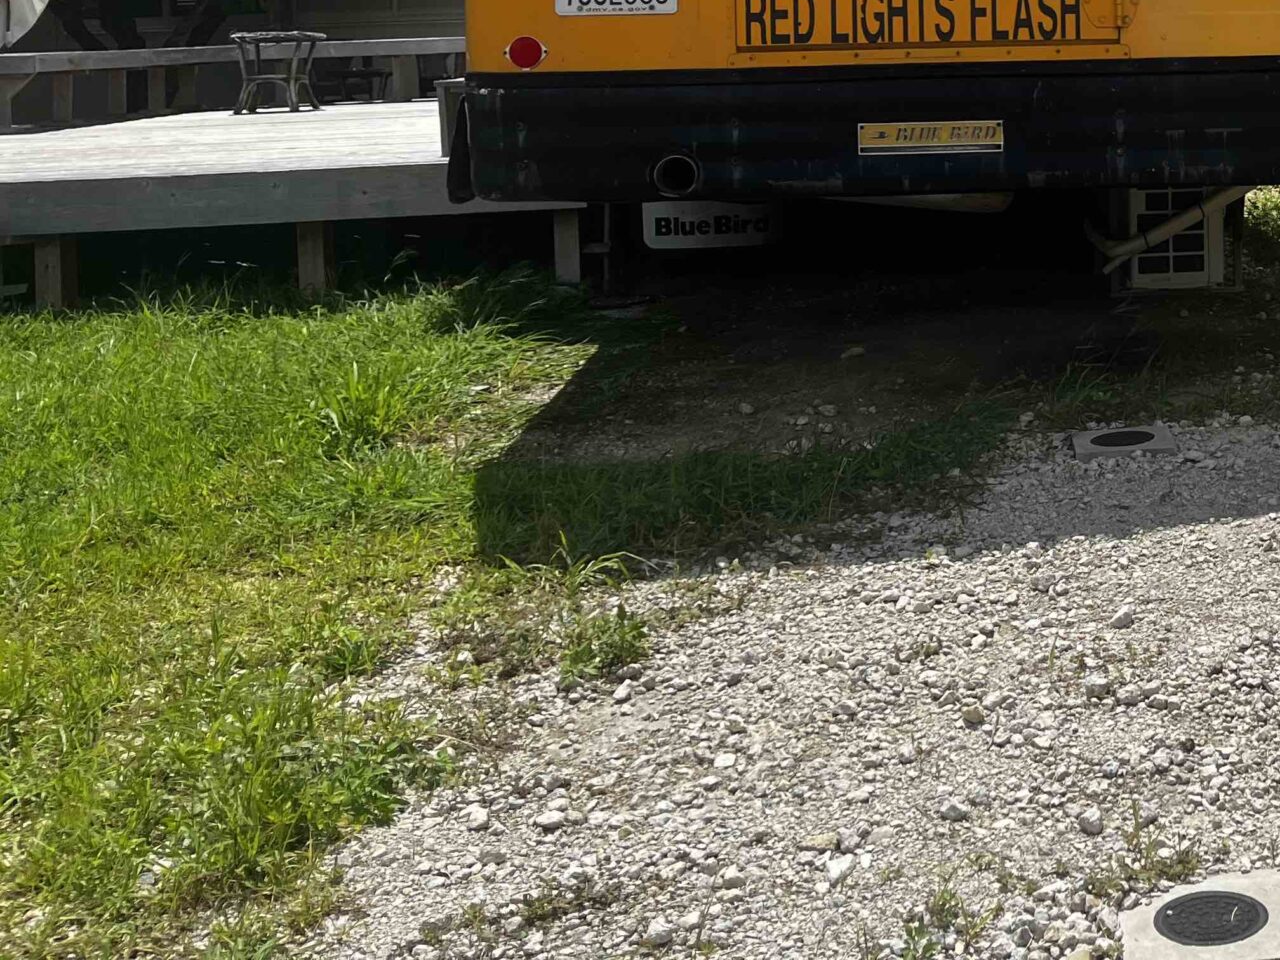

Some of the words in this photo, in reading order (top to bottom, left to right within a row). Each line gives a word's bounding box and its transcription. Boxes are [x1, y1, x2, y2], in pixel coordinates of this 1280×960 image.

[584, 6, 648, 14] dmv.ca.gov
[895, 126, 943, 142] BLUE
[654, 216, 711, 238] Blue
[713, 214, 770, 237] Bird
